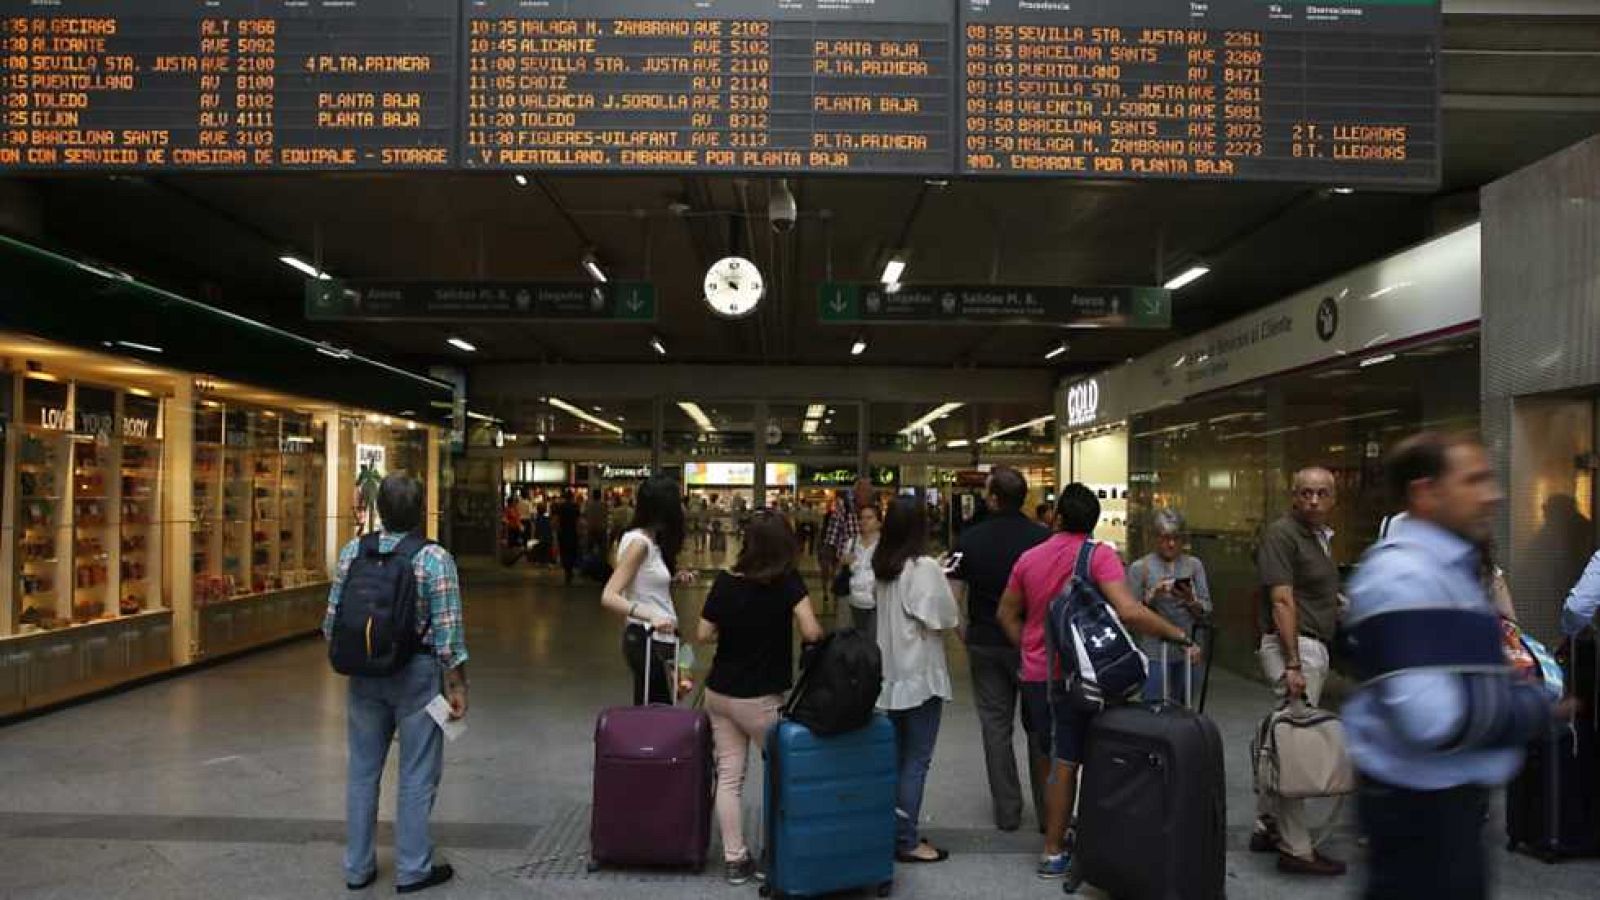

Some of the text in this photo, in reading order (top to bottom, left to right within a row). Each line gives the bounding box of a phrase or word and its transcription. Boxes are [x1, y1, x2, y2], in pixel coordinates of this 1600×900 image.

[32, 19, 117, 34] ALGECIRAS
[471, 20, 517, 34] 10:35
[522, 20, 577, 35] MALAGA
[613, 20, 689, 35] ZAMBRANO
[694, 21, 721, 35] AVE
[731, 22, 770, 36] 2102
[967, 26, 1014, 40] 08:55
[1018, 26, 1084, 42] SEVILLA
[1092, 28, 1127, 43] STA.
[1139, 29, 1185, 44] JUSTA
[1188, 30, 1207, 45] AV
[32, 38, 106, 52] ALICANTE
[201, 38, 230, 53] AVE
[471, 38, 919, 56] 10:45 ALICANTE AVE 5102 PLANTA BAJA
[967, 44, 1013, 59] 08:55
[1018, 44, 1103, 61] BARCELONA
[1111, 47, 1157, 62] SANTS
[1188, 49, 1216, 64] AVE
[31, 56, 97, 71] SEVILLA
[104, 57, 140, 71] STA.
[153, 57, 197, 71] JUSTA
[201, 57, 230, 72] AVE
[237, 57, 275, 71] 2100
[319, 56, 430, 72] PLTA.PRIMERA
[470, 56, 928, 75] 11:00 SEVILLA STA. JUSTA AVE 2110 PLTA.PRIMERA
[1018, 63, 1120, 79] PUERTOLLANO
[1188, 67, 1207, 81] AV
[31, 75, 134, 89] PUERTOLLANO
[201, 76, 220, 89] AV
[470, 75, 516, 89] 11:05
[520, 75, 568, 89] CADIZ
[731, 77, 768, 91] 2114
[967, 81, 1013, 95] 09:15
[1018, 81, 1084, 97] SEVILLA
[1091, 83, 1127, 98] STA.
[1139, 84, 1185, 99] JUSTA
[1188, 85, 1216, 100] AVE
[32, 93, 88, 107] TOLEDO
[200, 94, 220, 107] AV
[318, 93, 375, 108] PLANTA
[383, 93, 420, 108] BAJA
[470, 94, 516, 108] 11:10
[521, 93, 595, 108] VALENCIA
[603, 94, 688, 109] J.SOROLLA
[693, 95, 720, 109] AVE
[814, 97, 871, 112] PLANTA
[880, 97, 919, 112] BAJA
[1018, 99, 1093, 115] VALENCIA
[1101, 101, 1185, 117] J.SOROLLA
[1188, 103, 1216, 118] AVE
[31, 112, 78, 126] GIJON
[200, 112, 229, 126] ALV
[236, 112, 273, 126] 4111
[318, 112, 374, 127] PLANTA
[382, 112, 420, 127] BAJA
[469, 112, 515, 126] 11:20
[521, 112, 576, 126] TOLEDO
[692, 114, 711, 127] AV
[31, 130, 114, 145] BARCELONA
[122, 130, 169, 145] SANTS
[200, 131, 228, 145] AVE
[967, 118, 1014, 132] 09:50
[1018, 118, 1103, 133] BARCELONA
[1111, 120, 1157, 135] SANTS
[1188, 122, 1216, 137] AVE
[1333, 126, 1407, 141] LLEGADAS
[468, 131, 514, 145] 11:30
[518, 130, 678, 146] FIGUERES-VILAFANT
[692, 131, 720, 146] AVE
[814, 133, 927, 149] PLTA.PRIMERA
[967, 136, 1014, 151] 09:50
[1018, 136, 1074, 152] MALAGA
[1110, 138, 1185, 153] ZAMBRANO
[1188, 141, 1216, 155] AVE
[1333, 144, 1407, 159] LLEGADAS
[29, 149, 57, 163] CON
[64, 149, 138, 164] SERVICIO
[147, 149, 166, 163] DE
[173, 149, 247, 164] CONSIGNA
[255, 149, 273, 164] DE
[281, 149, 356, 165] EQUIPAJE
[382, 149, 447, 165] STORAGE
[481, 150, 492, 164] Y
[621, 150, 697, 164] EMBARQUE
[706, 150, 734, 165] POR
[743, 151, 800, 166] PLANTA
[809, 152, 849, 166] BAJA
[1011, 155, 1086, 171] EMBARQUE
[1094, 156, 1123, 171] POR
[1131, 157, 1187, 173] PLANTA
[1195, 159, 1235, 174] BAJA
